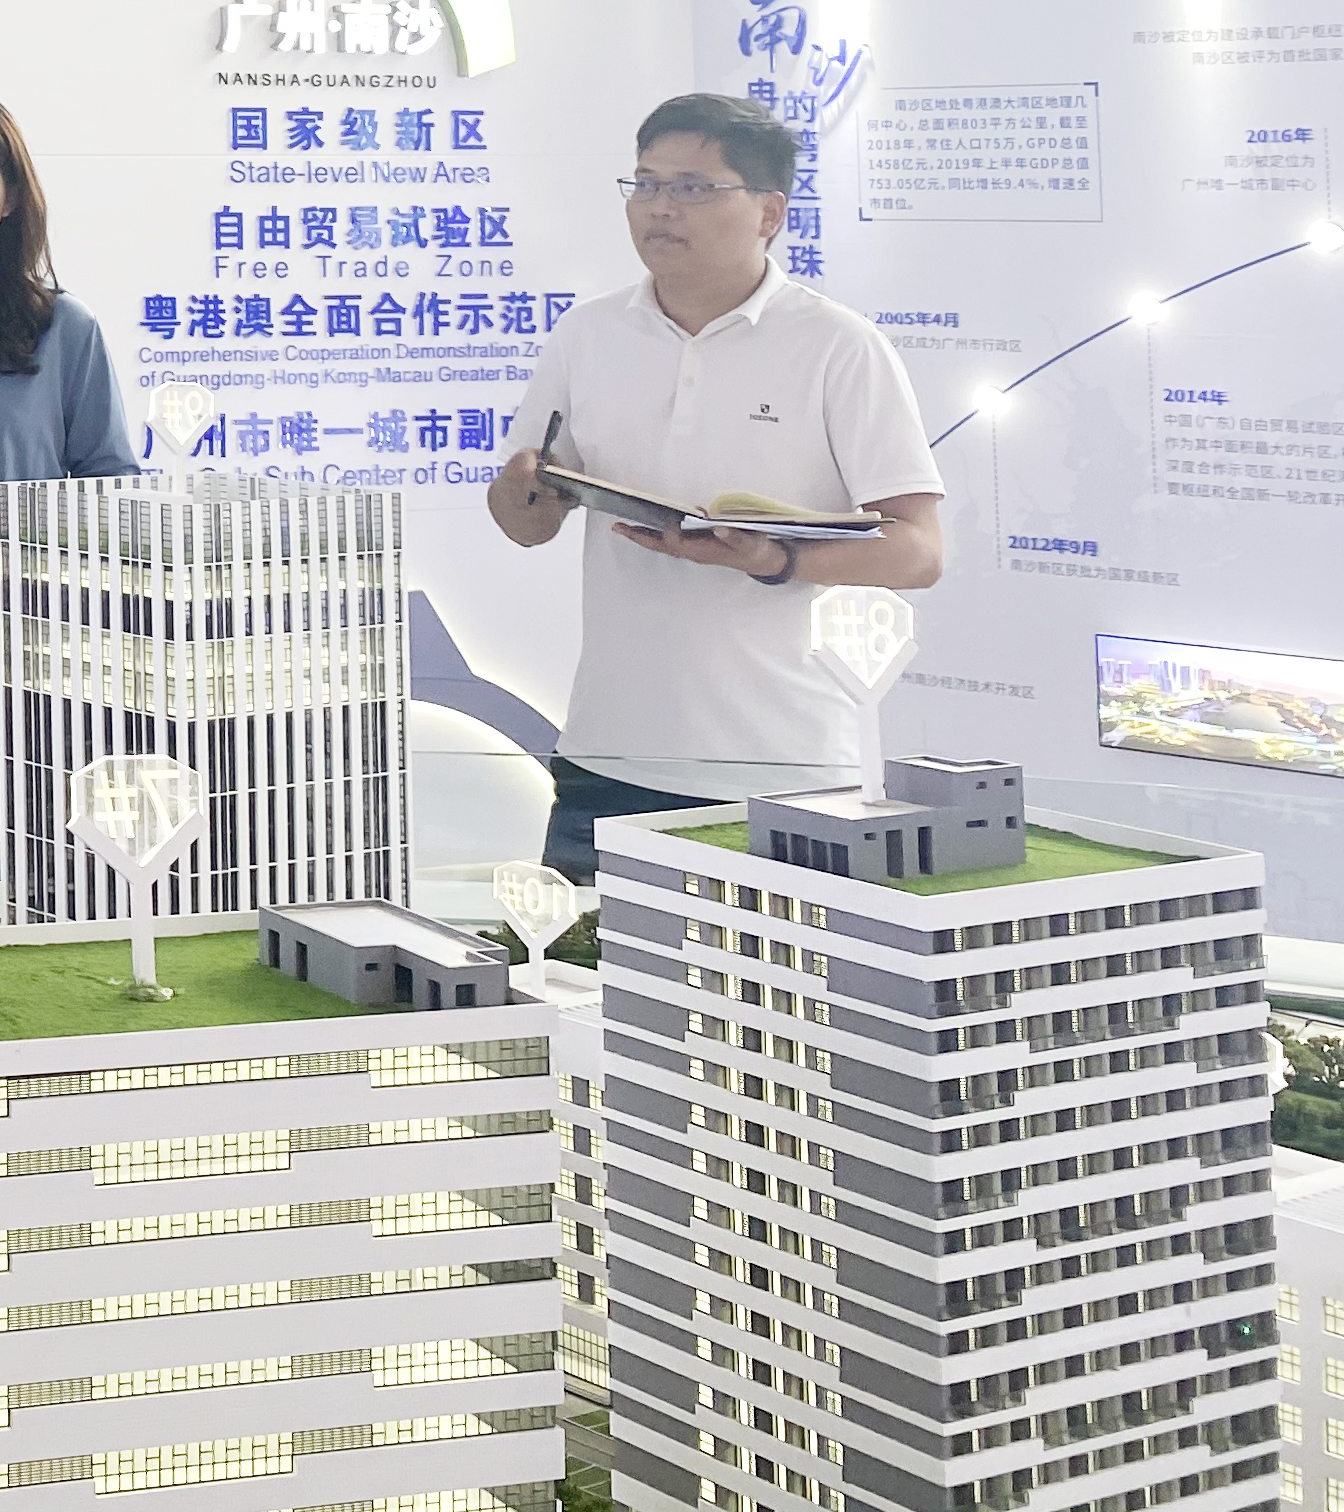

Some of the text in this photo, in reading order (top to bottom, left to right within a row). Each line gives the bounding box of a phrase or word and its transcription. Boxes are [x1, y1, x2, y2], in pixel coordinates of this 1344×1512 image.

[230, 106, 489, 152] 国家级新区
[1246, 127, 1315, 145] 2016年
[229, 160, 491, 184] State-level New Area
[1223, 154, 1316, 169] 南沙被定位为
[214, 205, 514, 250] 自由贸易试验区
[214, 254, 515, 278] Free Trade Zone
[875, 312, 960, 328] 2005年4月
[139, 346, 280, 366] Comprehensive
[285, 344, 390, 365] Cooperation
[395, 342, 520, 360] Demonstration
[139, 371, 156, 387] of
[324, 367, 433, 388] Kong-Macau
[438, 366, 502, 383] Greater
[1163, 388, 1230, 405] 2014年
[322, 464, 407, 486] Center
[413, 461, 438, 484] of
[1008, 535, 1099, 557] 2012年9月
